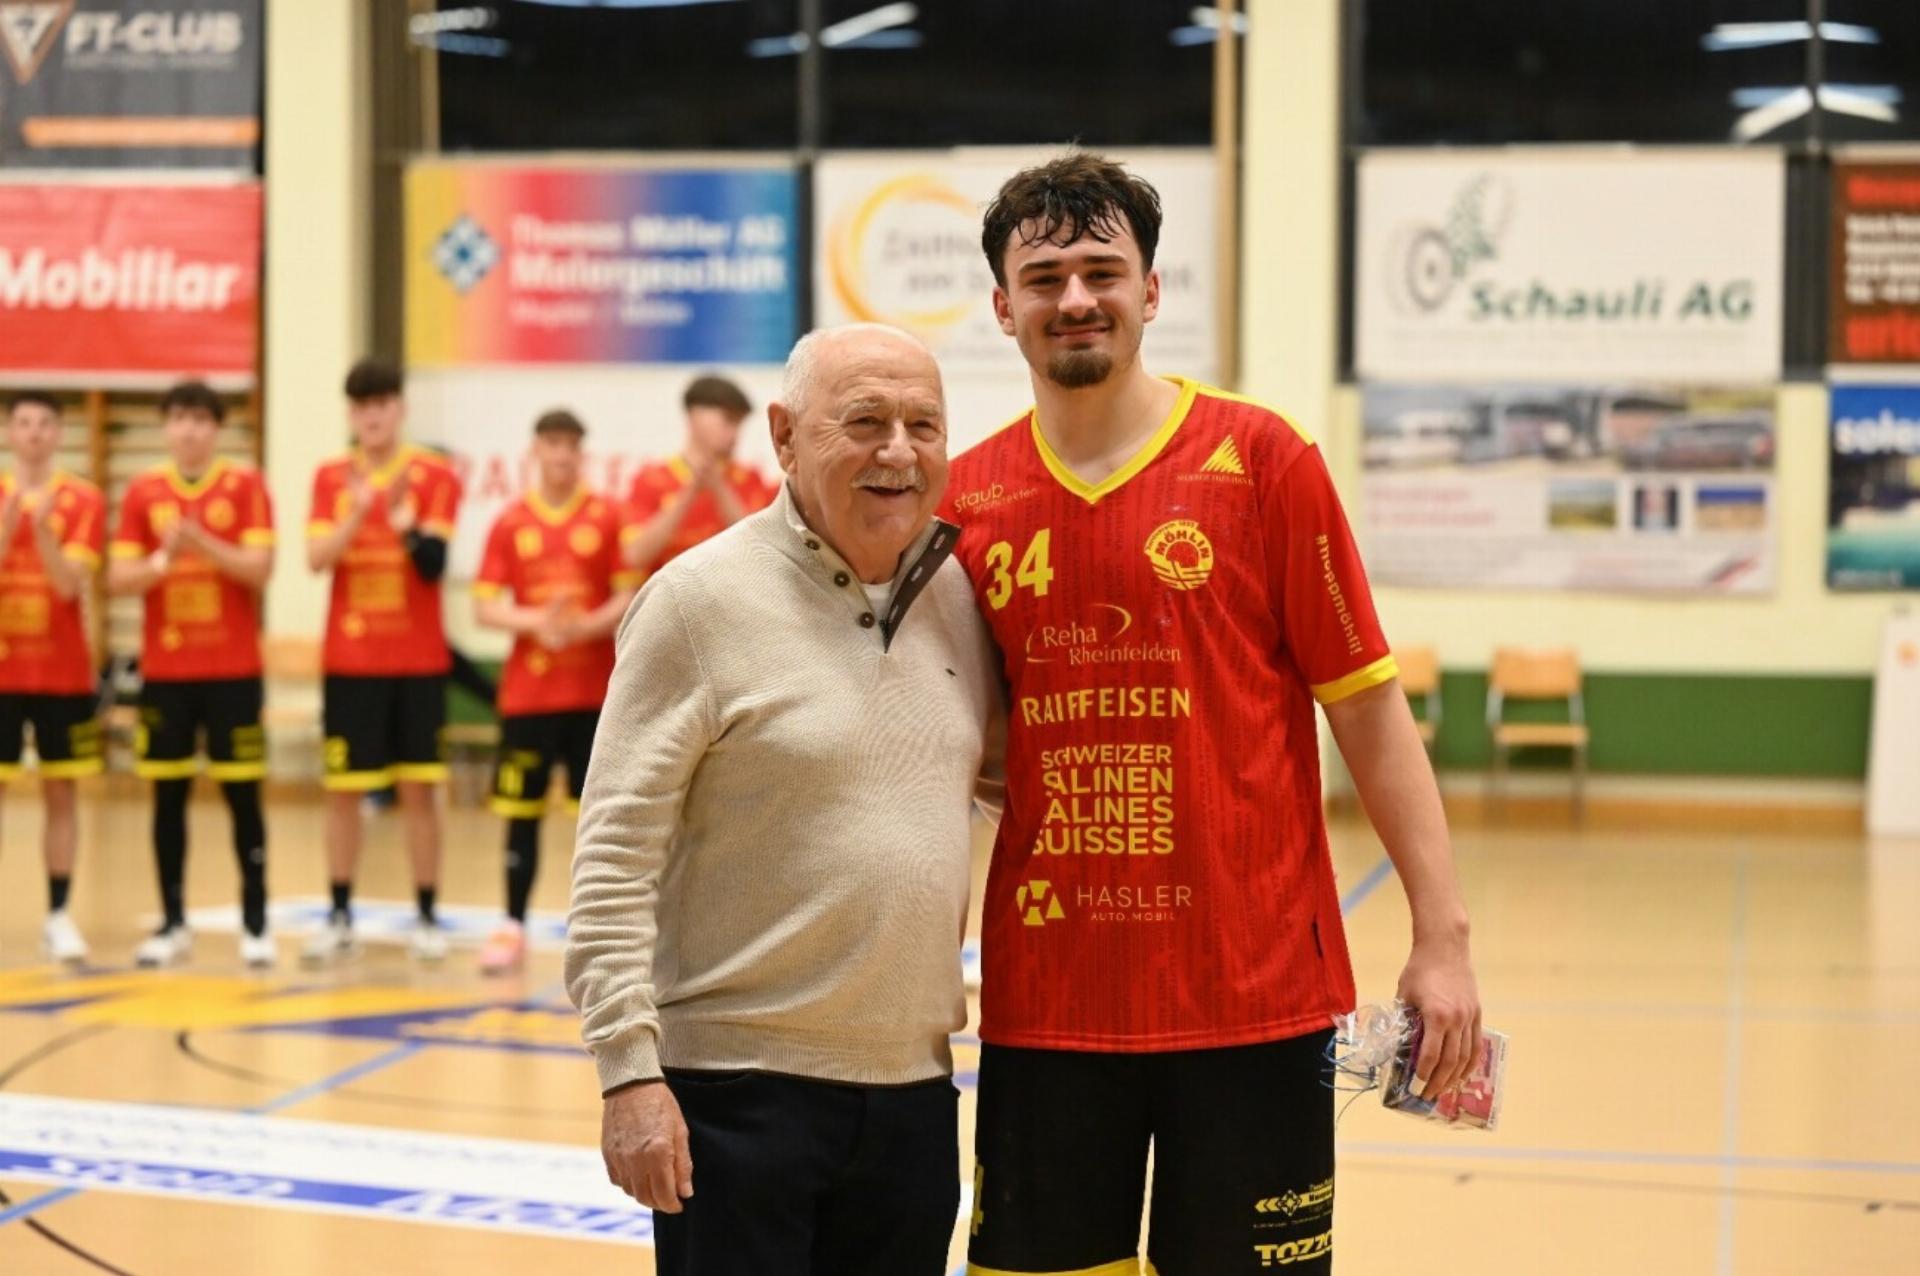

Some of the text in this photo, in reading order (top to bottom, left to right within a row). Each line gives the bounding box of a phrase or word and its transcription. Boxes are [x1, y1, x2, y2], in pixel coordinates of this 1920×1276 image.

[63, 10, 244, 54] FT-CLUB
[737, 214, 788, 251] AG
[0, 246, 241, 312] Mobiliar
[1469, 279, 1755, 323] Schauli AG
[954, 482, 1004, 514] staub
[1155, 528, 1210, 559] MÖHLIN
[985, 528, 1054, 611] 34
[1042, 611, 1098, 648] Reha
[1069, 641, 1181, 666] Rheinfelden
[1020, 687, 1191, 727] RAIFFEISEN
[1043, 796, 1175, 825] ALINES
[1077, 885, 1192, 907] HASLER
[1091, 911, 1176, 922] AUTO.MOBIL
